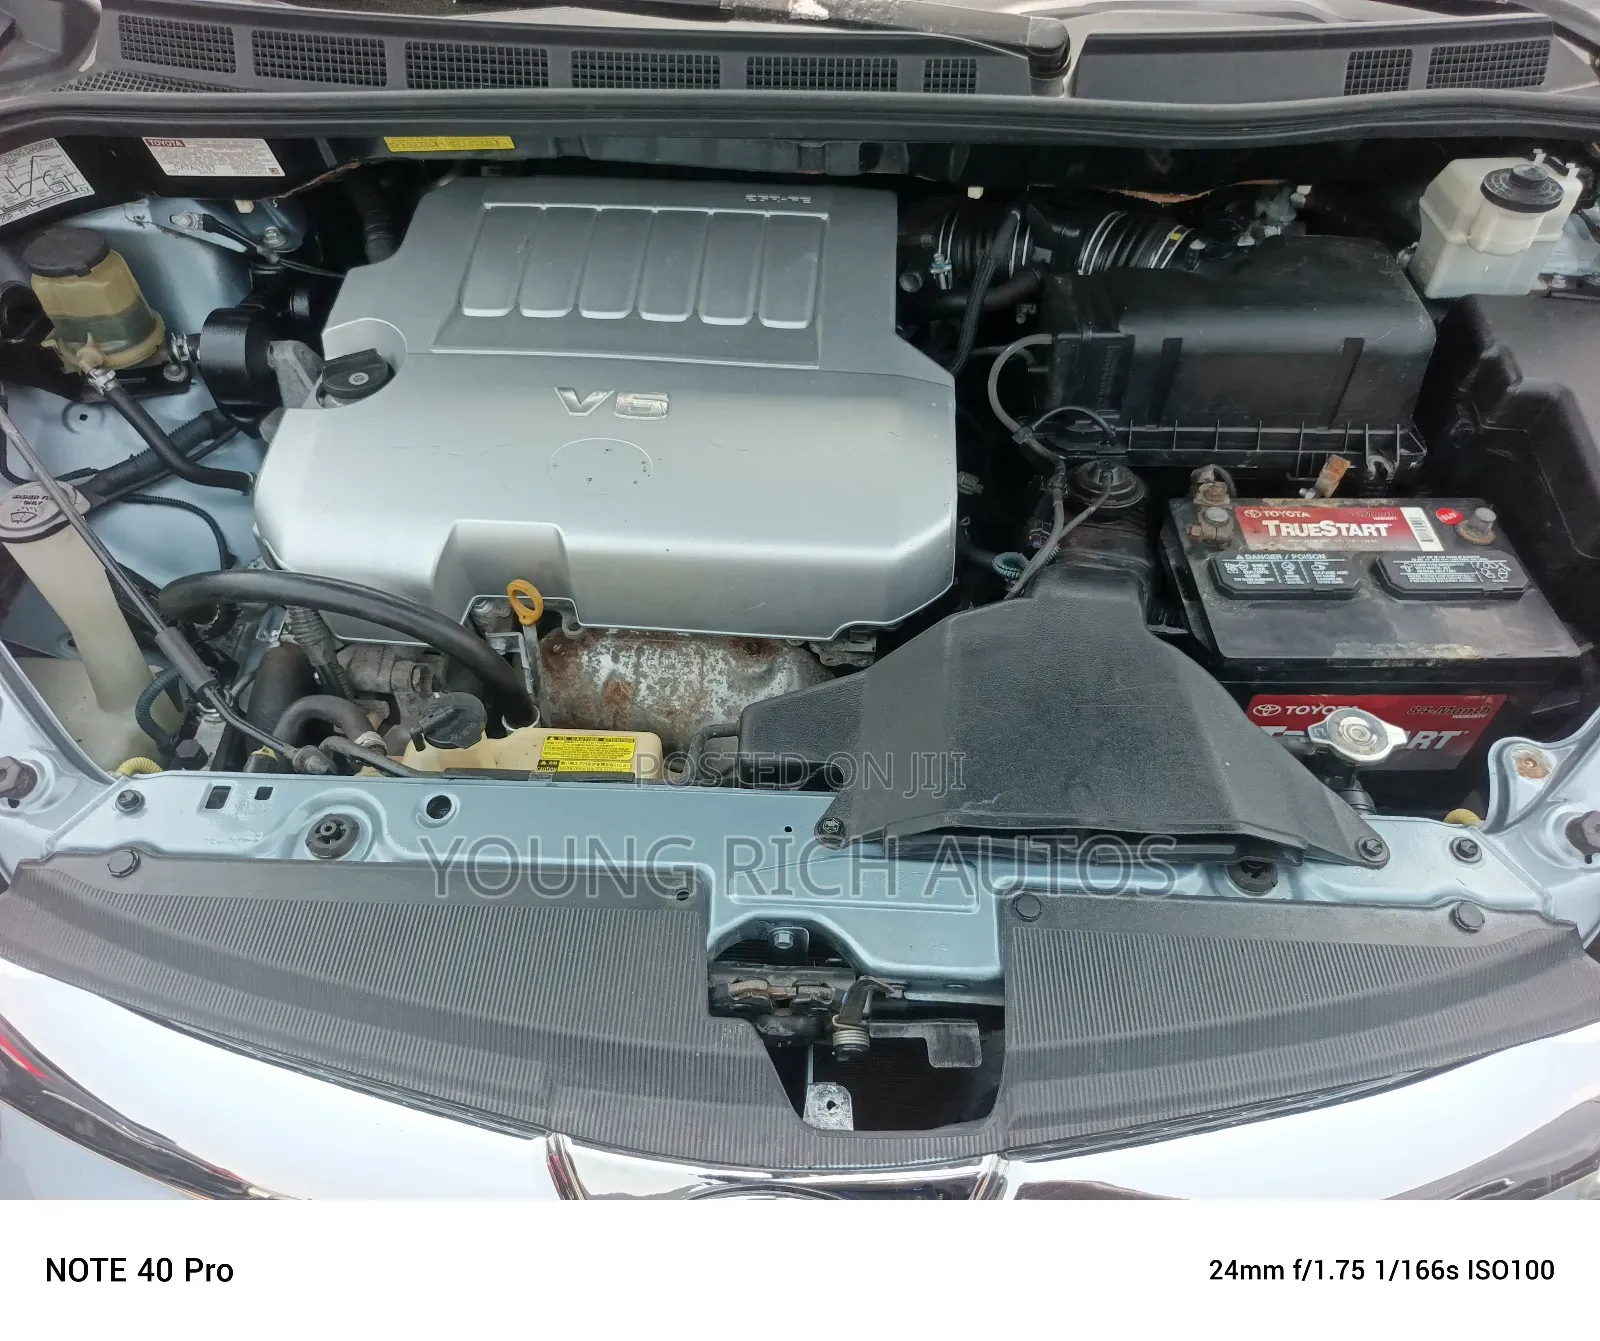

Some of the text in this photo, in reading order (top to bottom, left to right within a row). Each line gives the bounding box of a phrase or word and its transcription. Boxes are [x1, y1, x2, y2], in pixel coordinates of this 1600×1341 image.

[148, 139, 183, 147] TOYOTA
[553, 387, 669, 421] V6
[1262, 510, 1311, 518] TOYOTA
